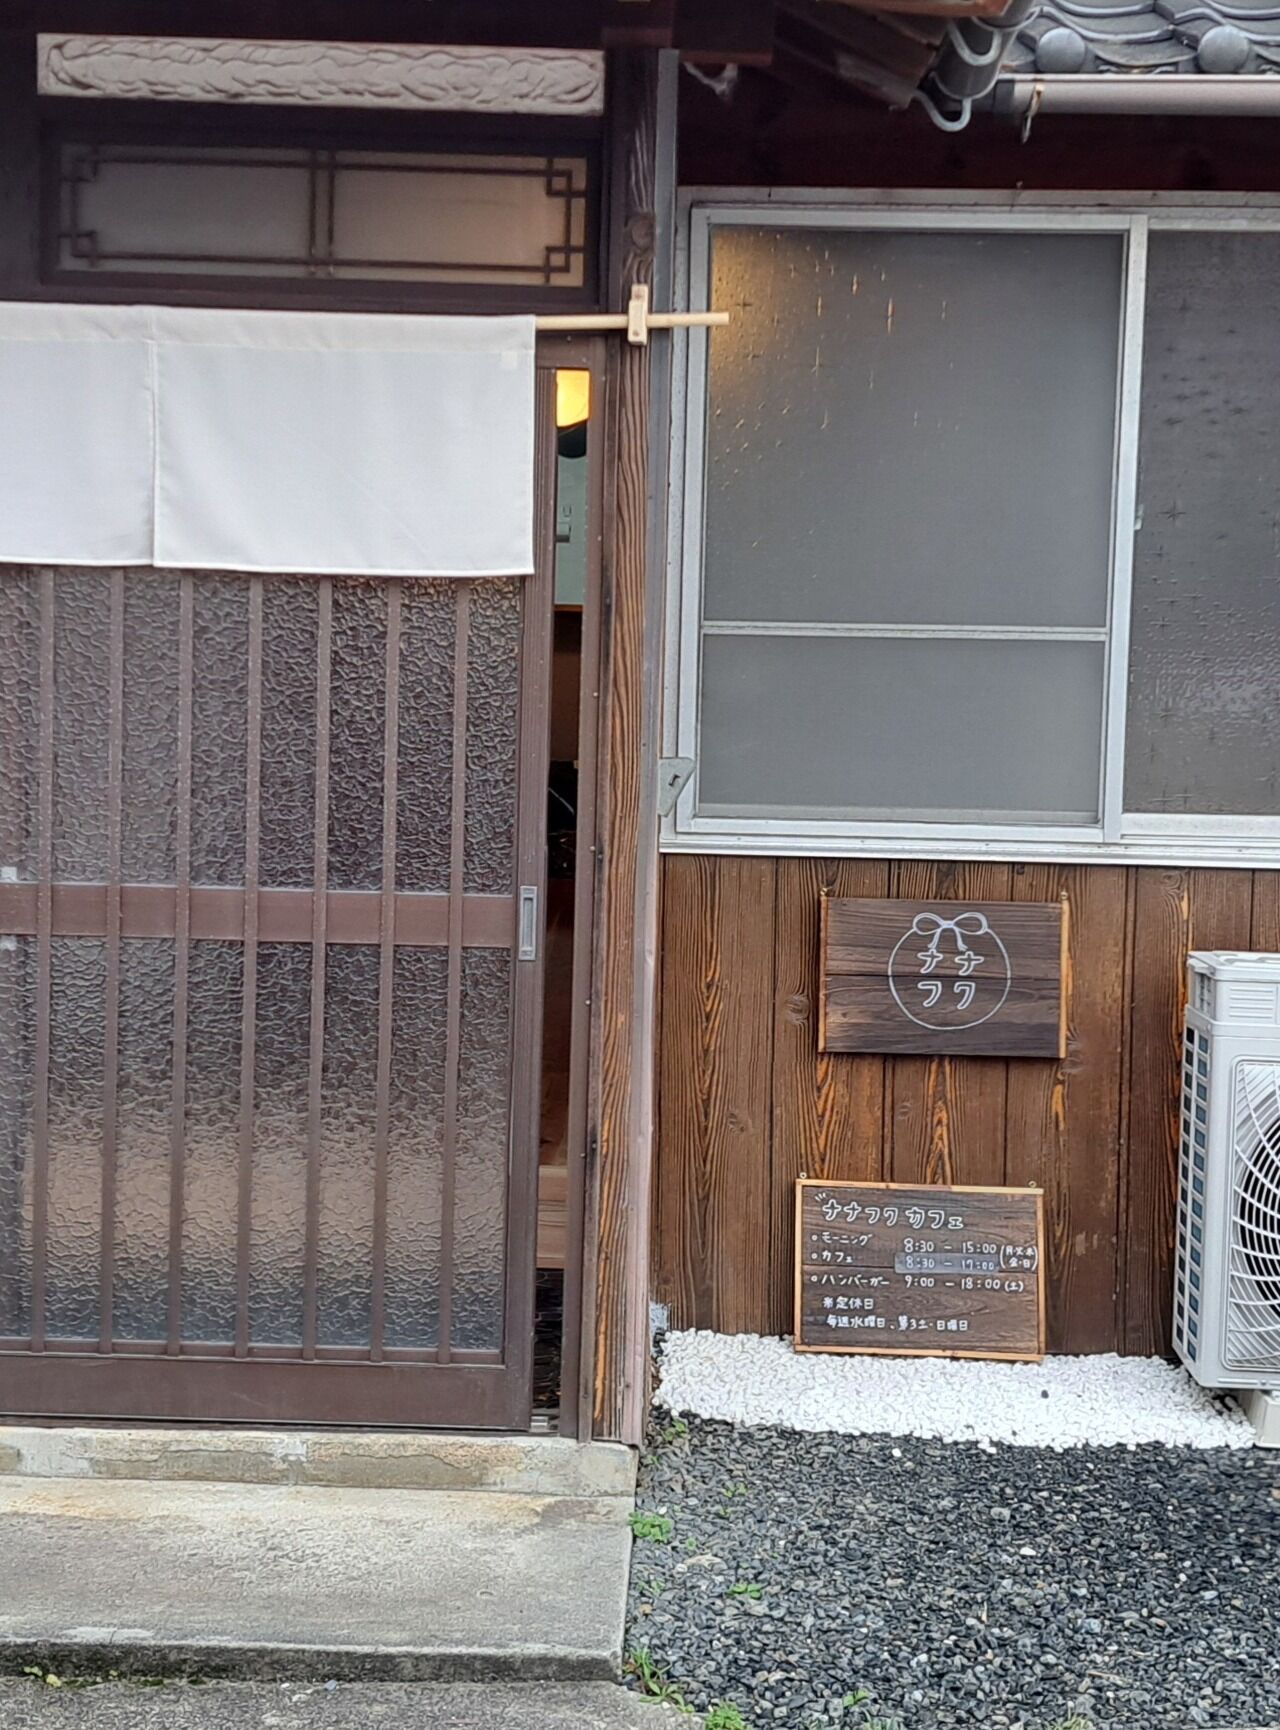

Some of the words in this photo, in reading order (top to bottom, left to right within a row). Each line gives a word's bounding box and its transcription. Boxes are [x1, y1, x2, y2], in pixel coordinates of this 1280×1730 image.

[917, 949, 984, 976] ナナ
[917, 981, 976, 1010] フク
[821, 1231, 873, 1246] モーニング
[904, 1237, 935, 1253] 8:30
[962, 1241, 997, 1254] 15:00
[821, 1250, 853, 1263] カフェ
[905, 1255, 935, 1269] 8:30
[961, 1259, 995, 1270] 17:00
[821, 1274, 890, 1288] ハンバーガー
[904, 1275, 935, 1289] 9:00
[961, 1278, 1001, 1290] 18:00
